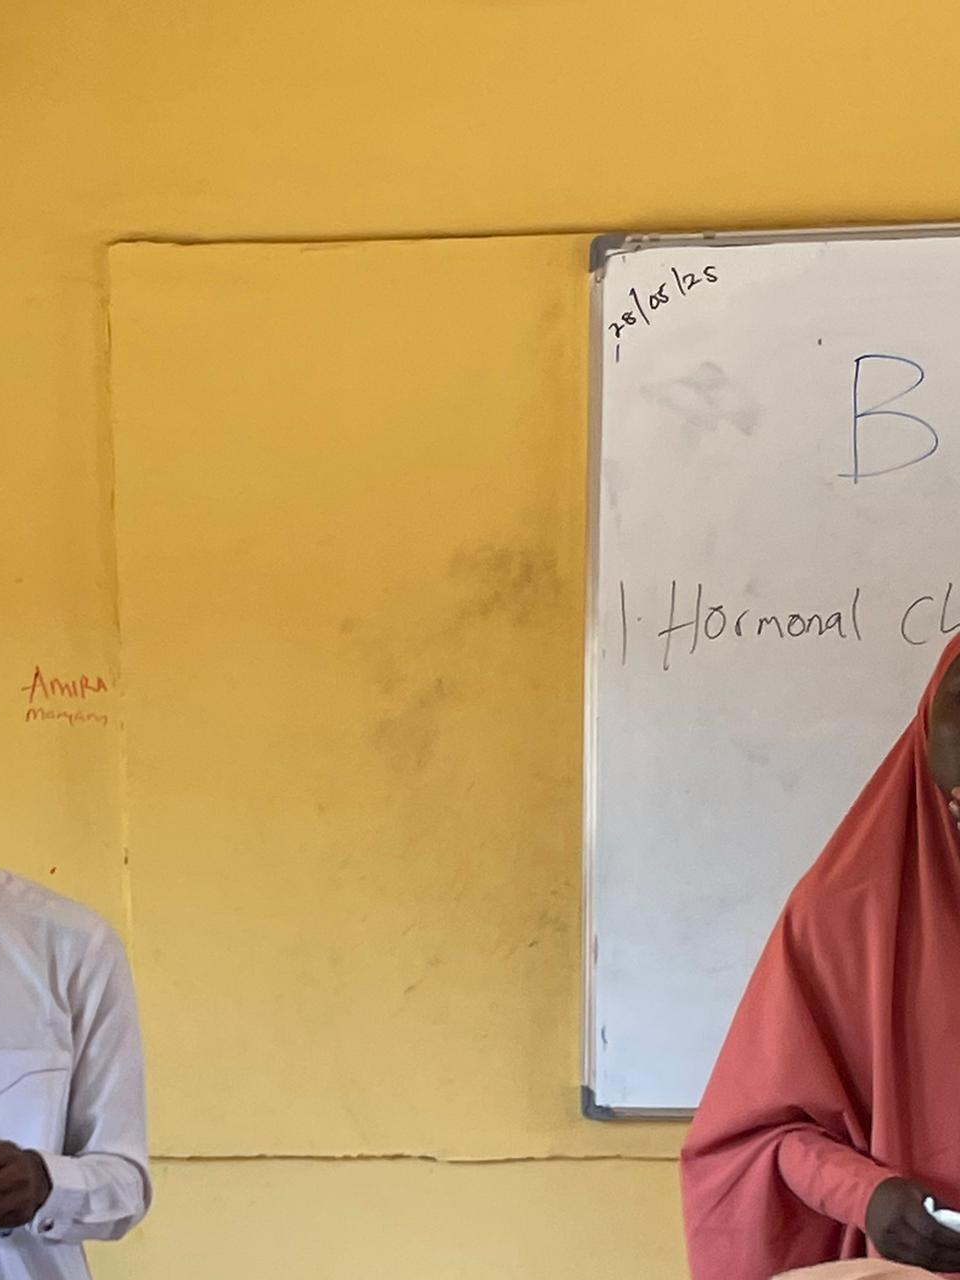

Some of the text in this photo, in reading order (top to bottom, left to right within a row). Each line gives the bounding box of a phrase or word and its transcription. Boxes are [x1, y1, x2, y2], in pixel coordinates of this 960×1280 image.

[608, 265, 718, 338] 28/05/25
[838, 353, 939, 484] B
[658, 580, 863, 671] Hormonal
